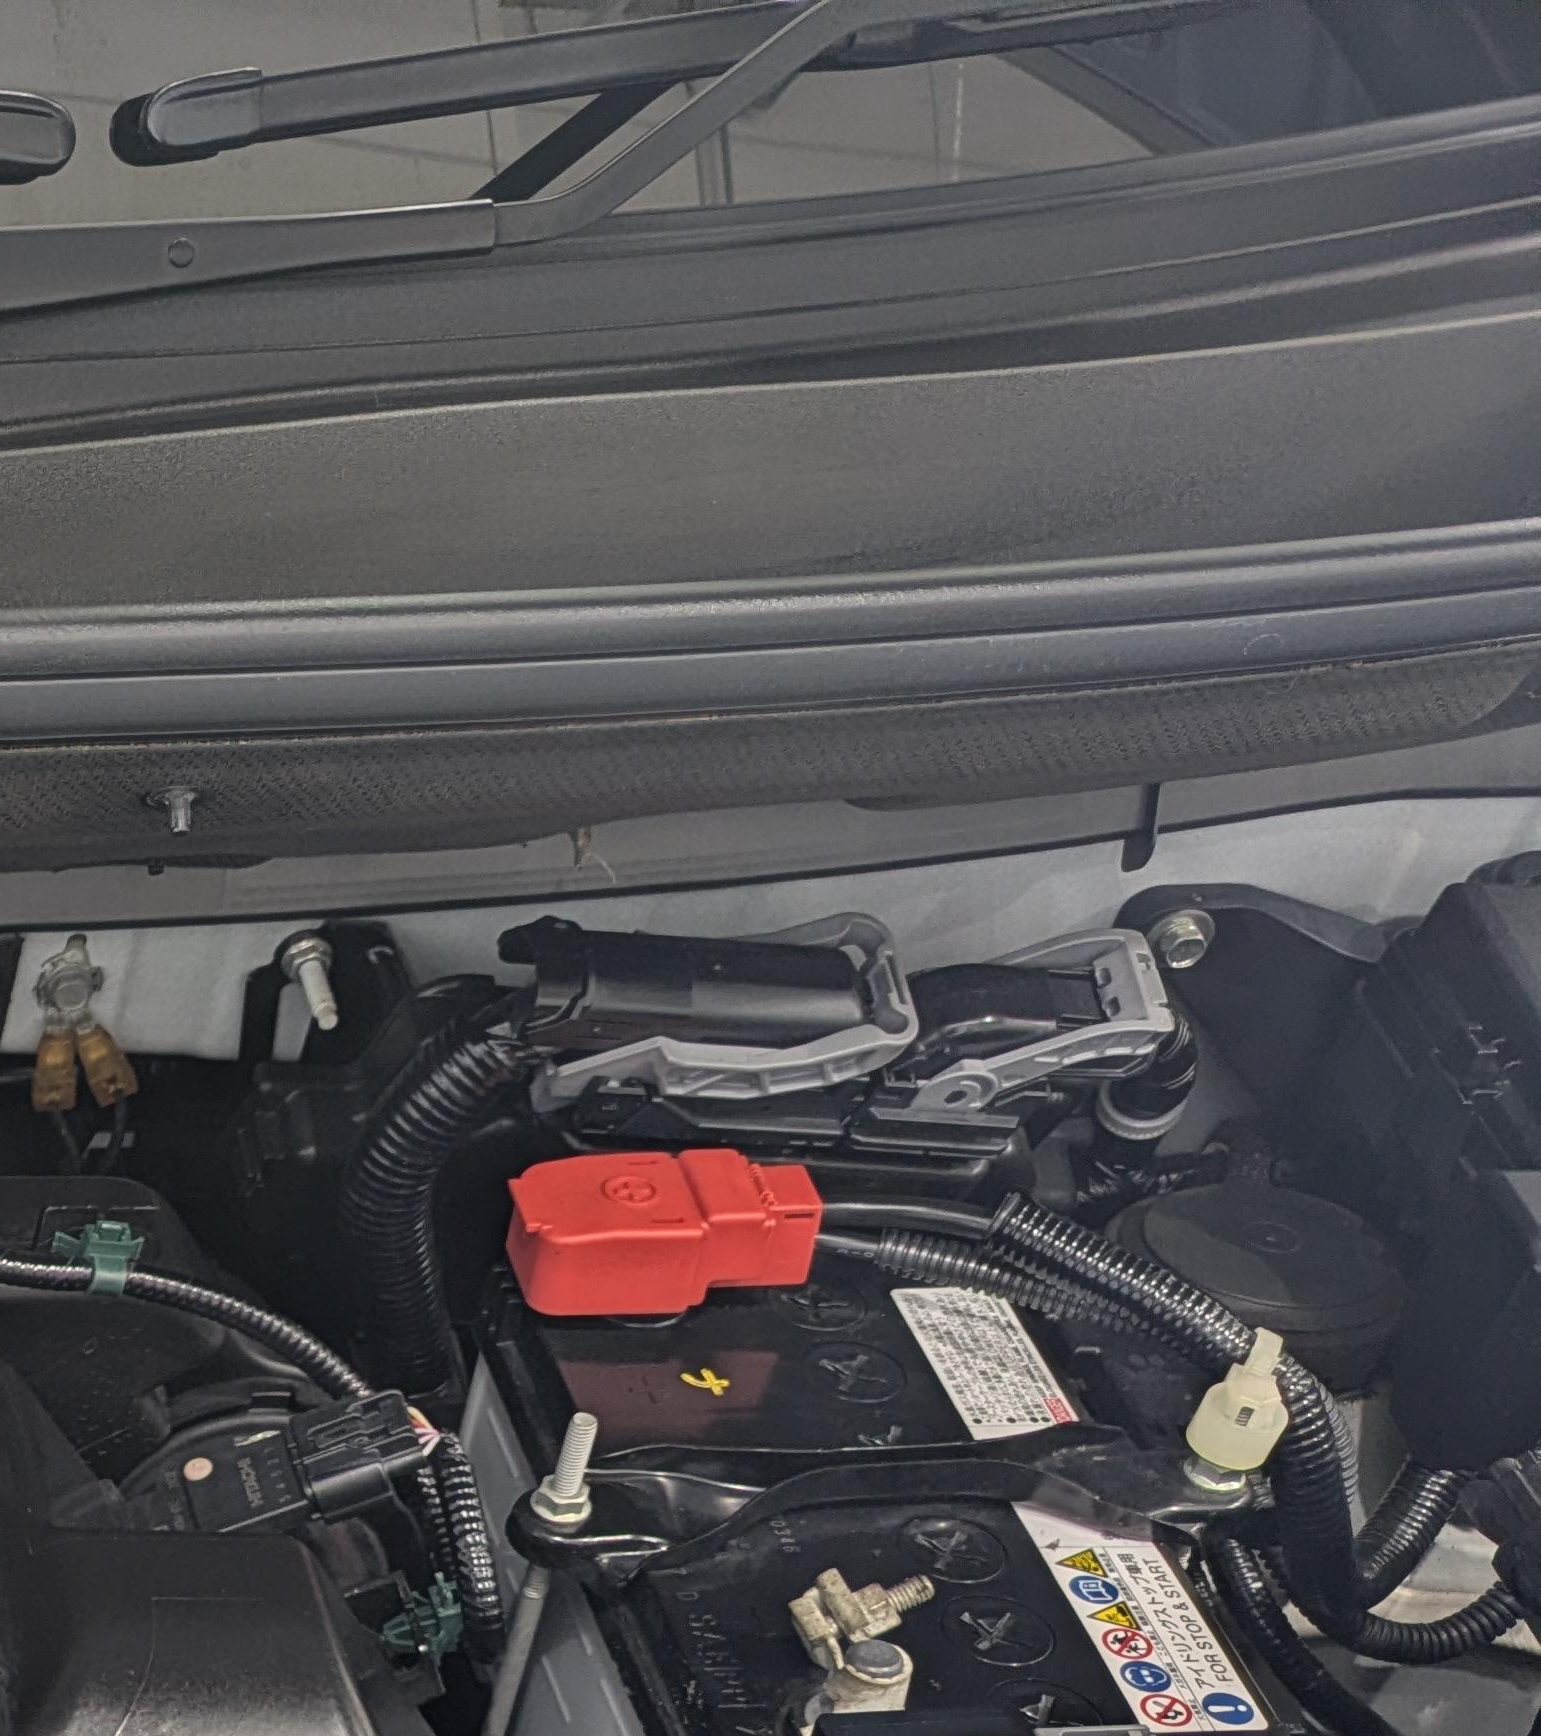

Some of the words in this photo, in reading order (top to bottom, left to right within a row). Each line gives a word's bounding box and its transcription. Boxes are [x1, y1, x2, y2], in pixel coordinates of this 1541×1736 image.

[1143, 1558, 1182, 1600] START
[1117, 1553, 1215, 1690] アイドリングストップ車用
[1173, 1601, 1190, 1611] &
[1180, 1615, 1214, 1650] STOP
[1203, 1653, 1234, 1683] FOR
